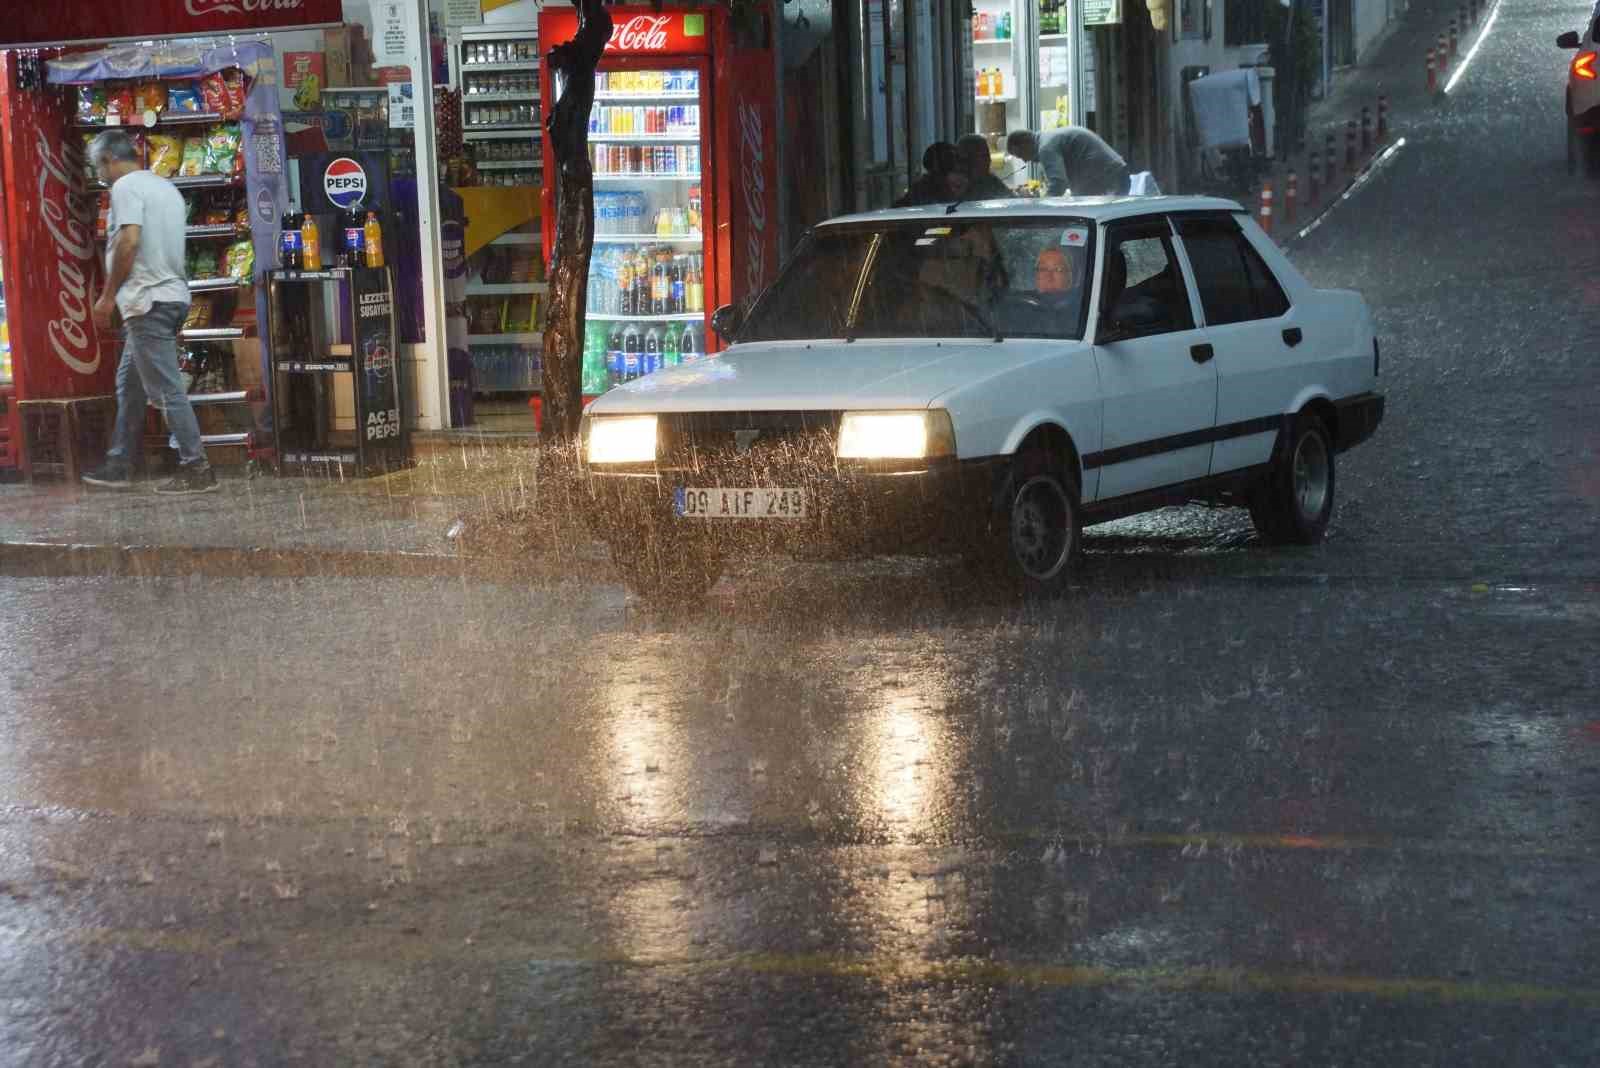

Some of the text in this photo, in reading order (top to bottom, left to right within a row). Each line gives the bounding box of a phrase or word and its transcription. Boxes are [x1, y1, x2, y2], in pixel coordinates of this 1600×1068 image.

[327, 177, 364, 189] PEPSI
[367, 422, 400, 440] PEPSI
[686, 489, 802, 515] 09 AIF 249
